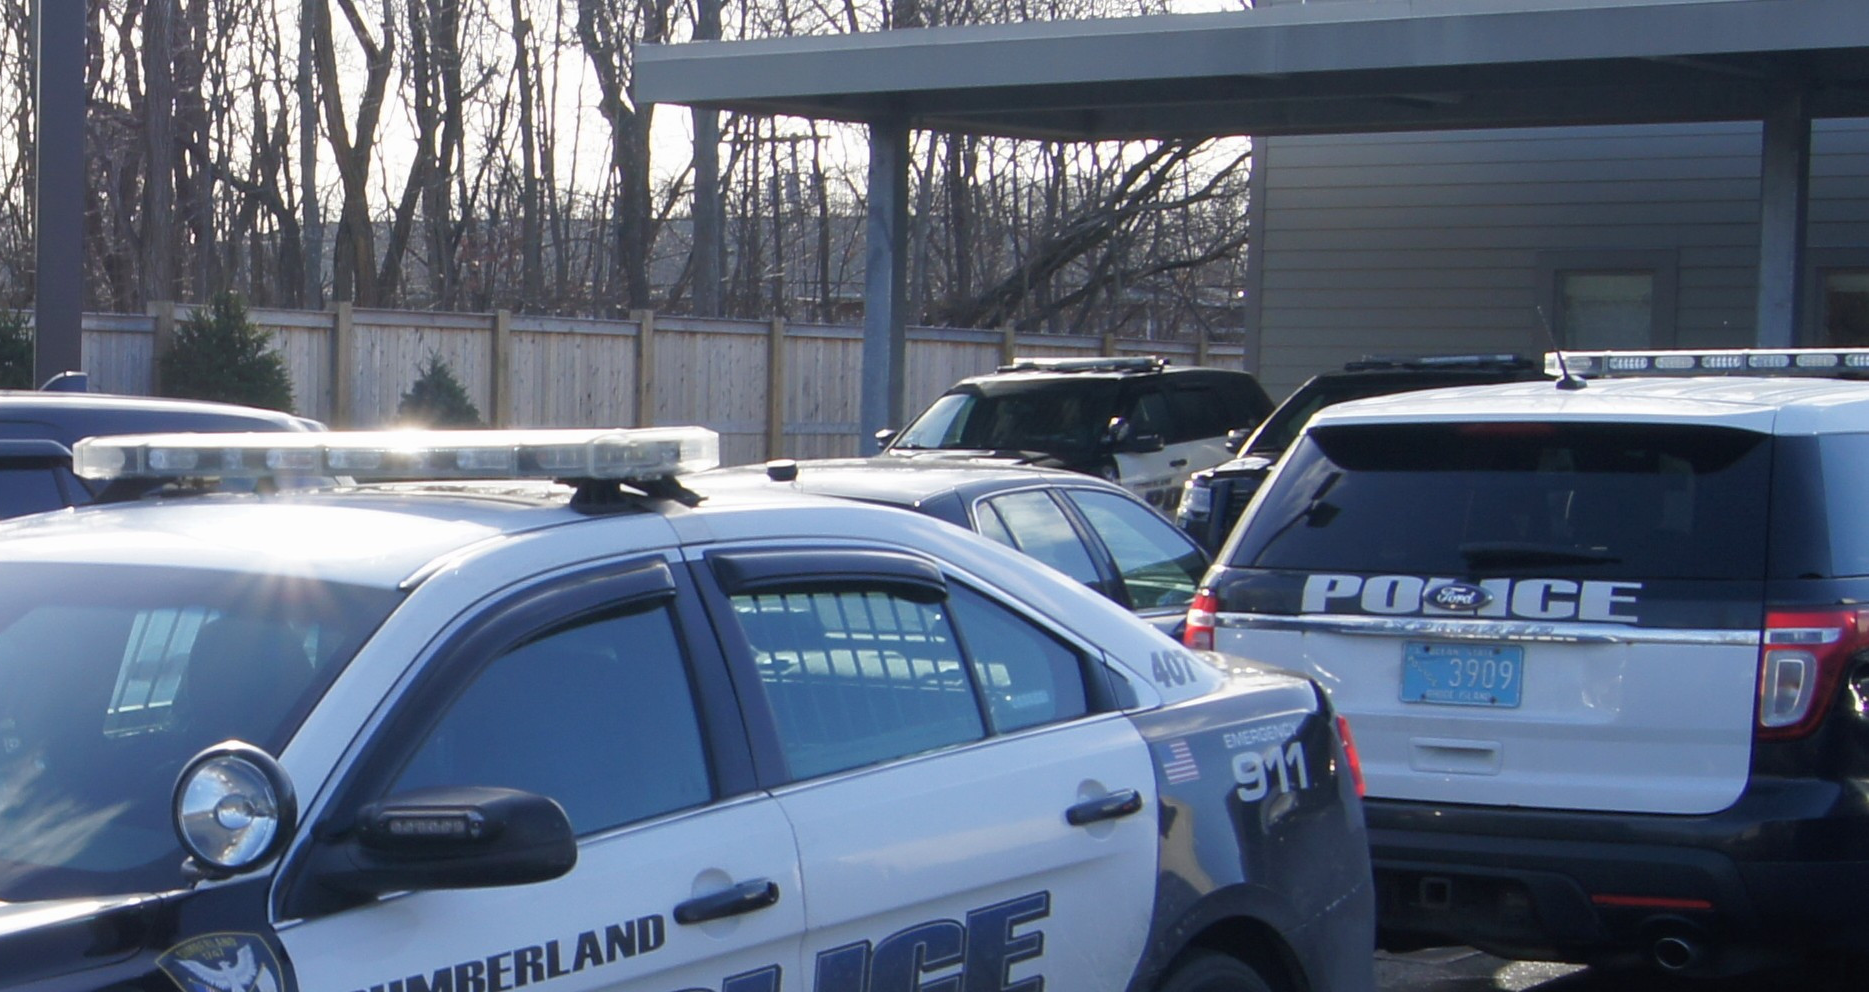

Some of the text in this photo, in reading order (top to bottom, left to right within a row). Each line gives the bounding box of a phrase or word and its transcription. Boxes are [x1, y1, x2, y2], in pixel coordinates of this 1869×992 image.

[1436, 586, 1476, 605] Ford
[1151, 651, 1197, 689] 407
[1448, 658, 1514, 690] 3909
[1232, 741, 1309, 802] 911
